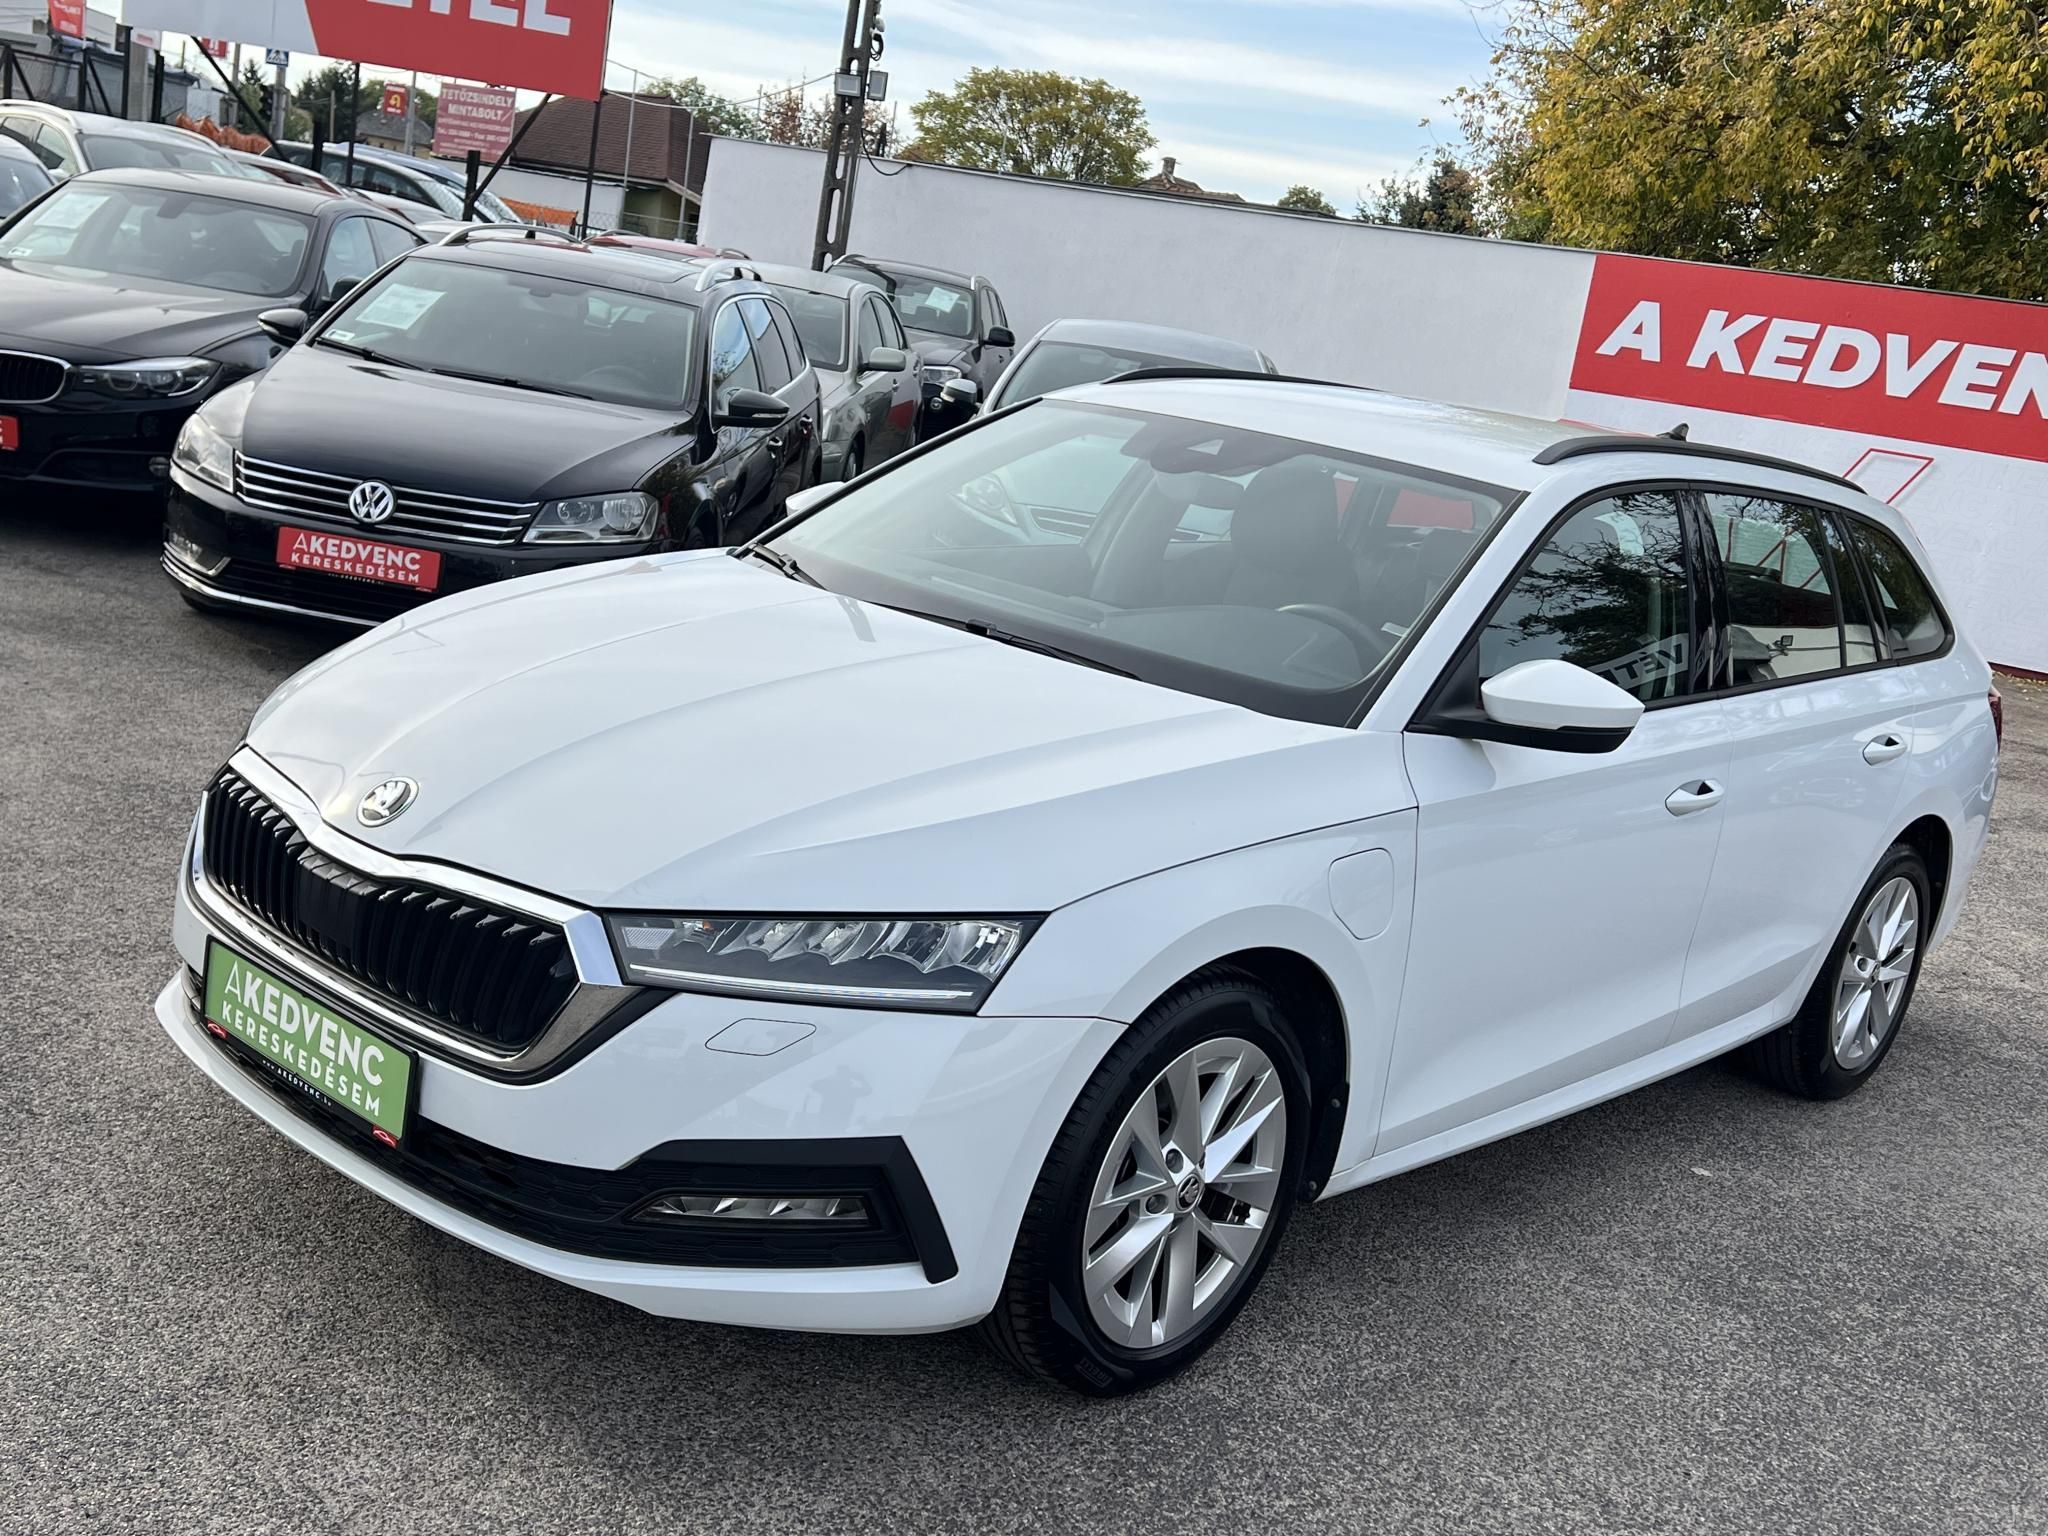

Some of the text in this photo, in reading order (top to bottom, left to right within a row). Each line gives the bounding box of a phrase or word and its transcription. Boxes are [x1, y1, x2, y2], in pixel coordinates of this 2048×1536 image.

[447, 103, 504, 121] MINTABOLT
[1595, 300, 1661, 363] A
[291, 552, 420, 584] KERESKEDÉSEM
[222, 1002, 380, 1117] KERESKEDÉSEM
